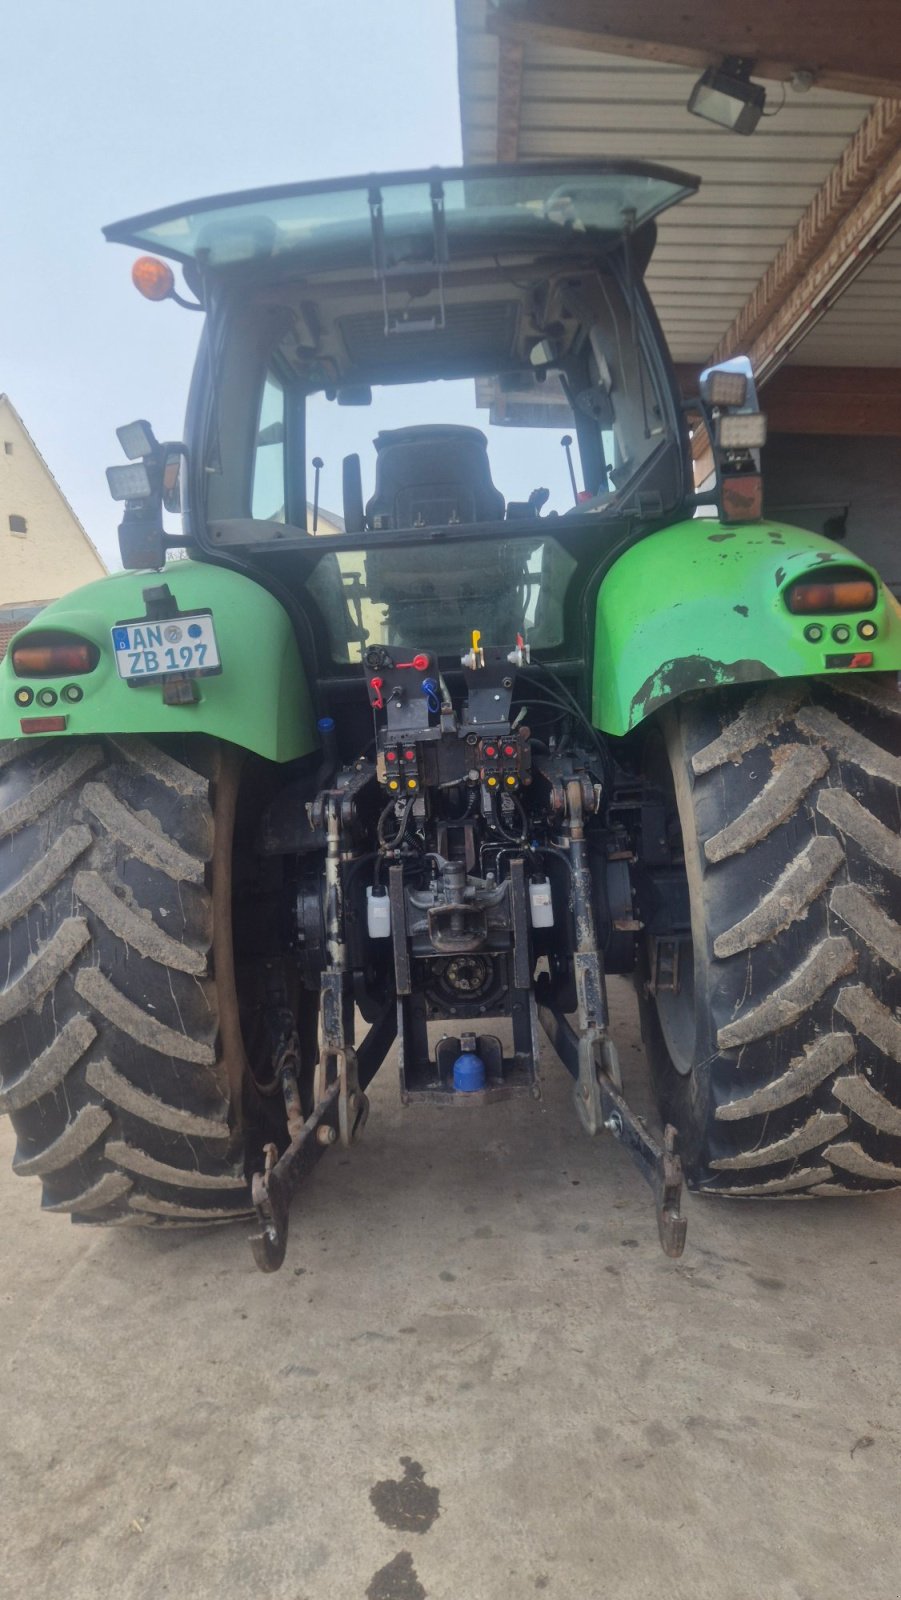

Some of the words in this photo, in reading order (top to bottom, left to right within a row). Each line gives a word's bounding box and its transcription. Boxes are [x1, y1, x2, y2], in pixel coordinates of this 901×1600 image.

[119, 641, 126, 649] D
[133, 625, 163, 650] AN
[127, 651, 159, 674] ZB
[164, 643, 208, 670] 197
